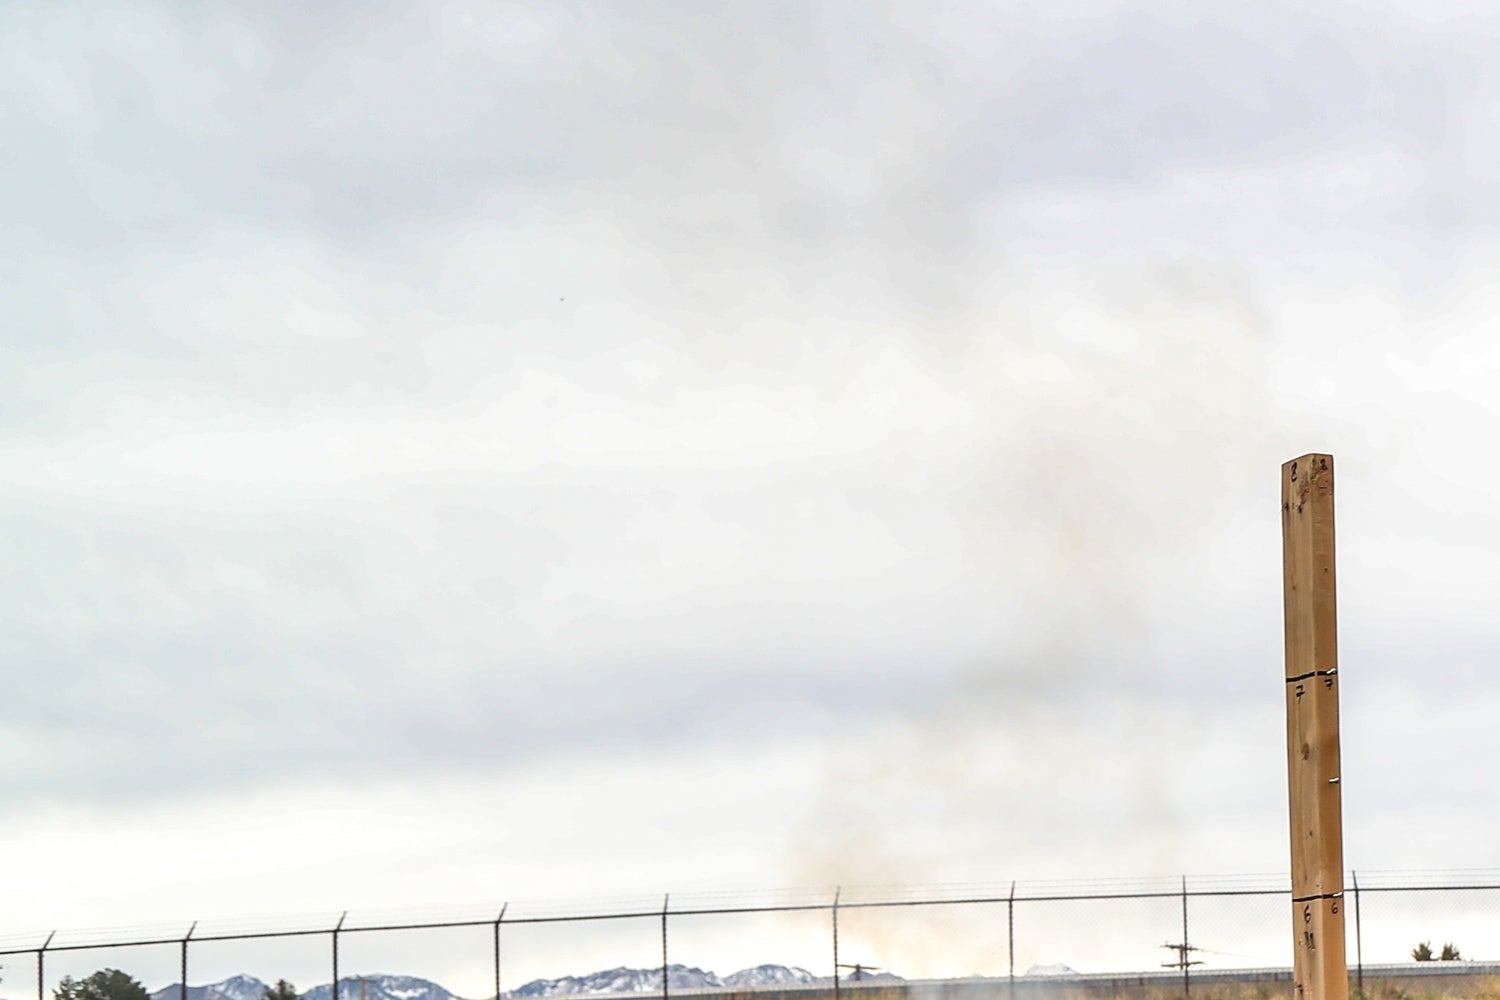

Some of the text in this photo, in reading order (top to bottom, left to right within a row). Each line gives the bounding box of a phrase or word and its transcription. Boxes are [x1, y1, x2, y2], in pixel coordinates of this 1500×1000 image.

[1290, 461, 1298, 482] 8
[1295, 684, 1306, 704] 7
[1303, 904, 1311, 923] 6
[1331, 901, 1339, 914] 6
